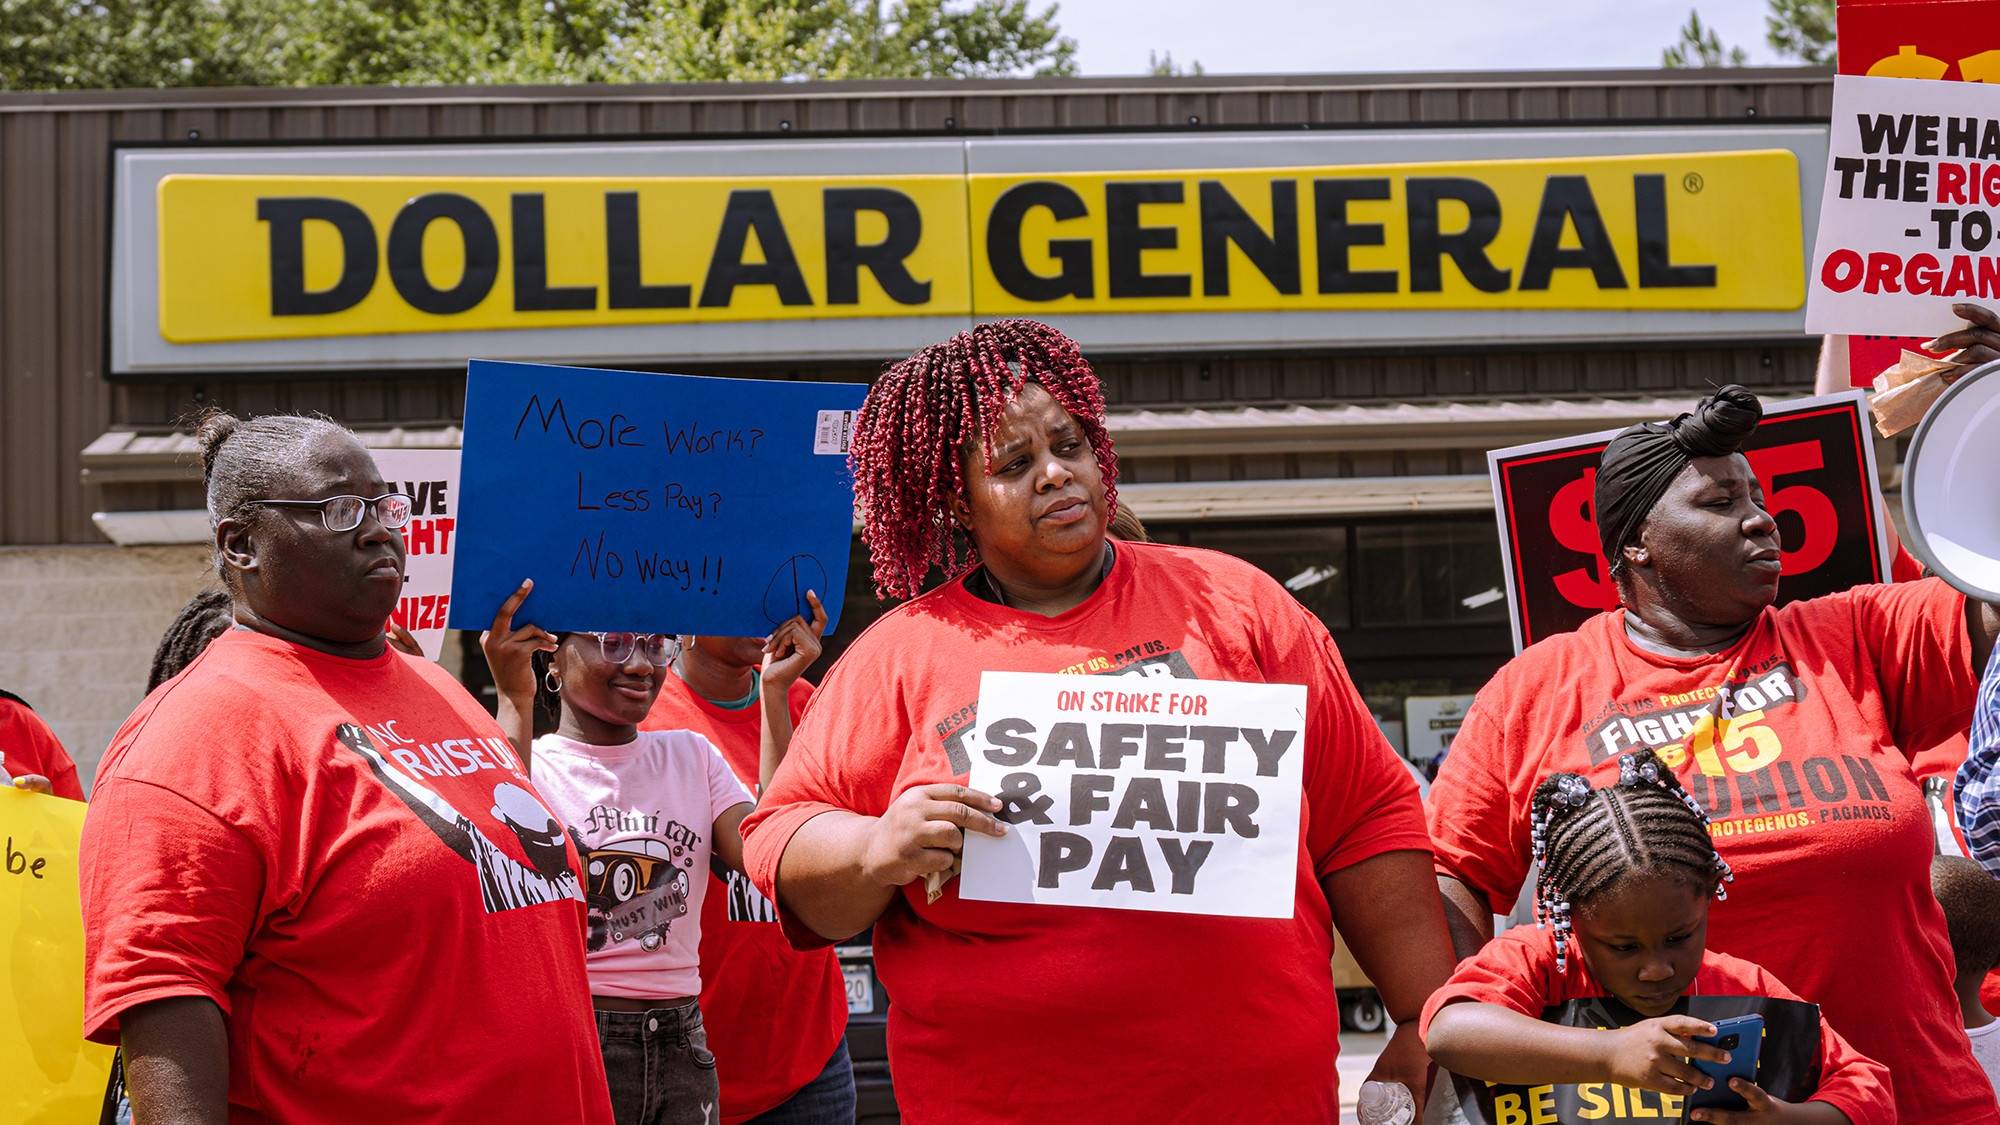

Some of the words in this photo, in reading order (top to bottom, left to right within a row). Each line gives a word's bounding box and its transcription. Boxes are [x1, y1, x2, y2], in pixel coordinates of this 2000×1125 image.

[1857, 113, 1940, 156] WE
[1834, 157, 1929, 203] THE
[256, 187, 932, 318] DOLLAR
[986, 174, 1717, 302] GENERAL
[514, 394, 645, 450] More
[664, 421, 765, 457] Work?
[577, 472, 651, 512] Less
[664, 483, 722, 519] Pay?
[571, 530, 624, 582] No
[1115, 646, 1142, 665] PAY
[1143, 639, 1170, 654] US.
[1057, 690, 1083, 712] ON
[1090, 691, 1162, 715] STRIKE
[1168, 693, 1208, 716] FOR
[365, 720, 415, 746] NC
[983, 717, 1297, 778] SAFETY
[390, 739, 496, 780] RAISE
[995, 772, 1055, 826] &
[1069, 774, 1260, 839] FAIR
[1692, 755, 1891, 818] UNION
[6, 836, 46, 879] be
[664, 820, 702, 852] car
[1037, 831, 1213, 895] PAY
[1495, 1084, 1559, 1125] BE
